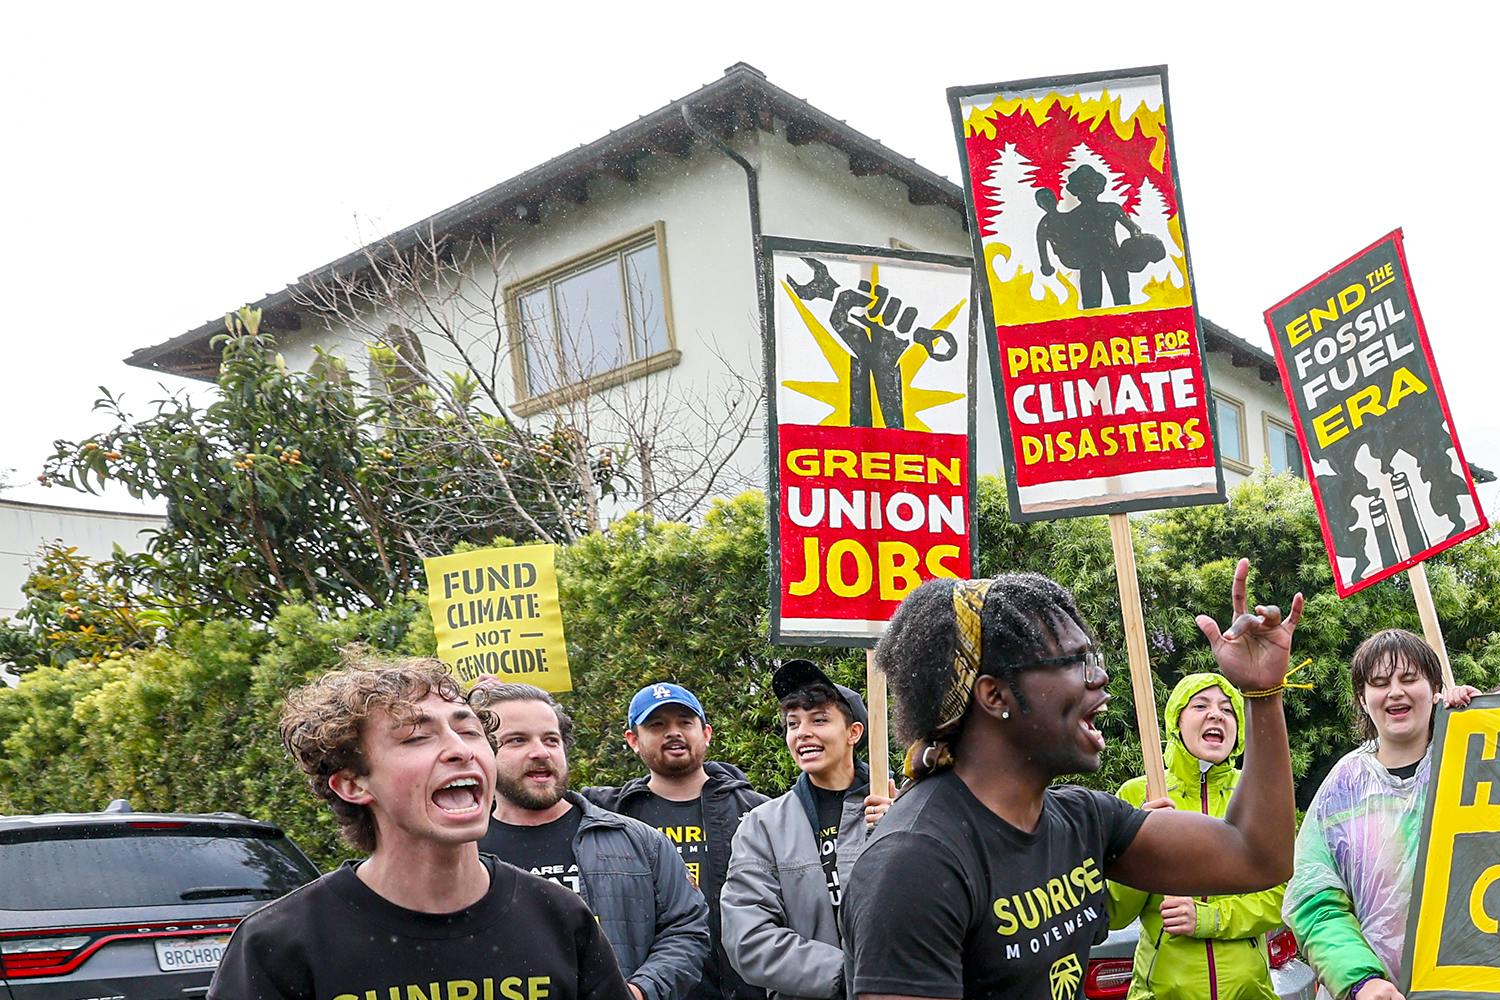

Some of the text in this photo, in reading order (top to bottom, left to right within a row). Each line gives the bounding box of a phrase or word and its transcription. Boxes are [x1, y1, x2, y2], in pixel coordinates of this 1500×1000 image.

[1285, 263, 1394, 348] END THE
[1007, 330, 1190, 378] PREPARE FOR
[1294, 298, 1406, 380] FOSSIL
[1302, 333, 1414, 410] FUEL
[1013, 368, 1198, 425] CLIMATE
[1312, 367, 1428, 450] ERA
[1022, 418, 1205, 466] DISASTERS
[787, 448, 960, 485] GREEN
[788, 488, 964, 535] UNION
[444, 563, 537, 599] FUND
[447, 593, 540, 629] CLIMATE
[475, 629, 511, 647] NOT
[456, 648, 549, 682] GENOCIDE
[529, 865, 564, 875] ARE
[164, 947, 226, 966] 8RCH80
[1005, 907, 1098, 959] MOVEMEN
